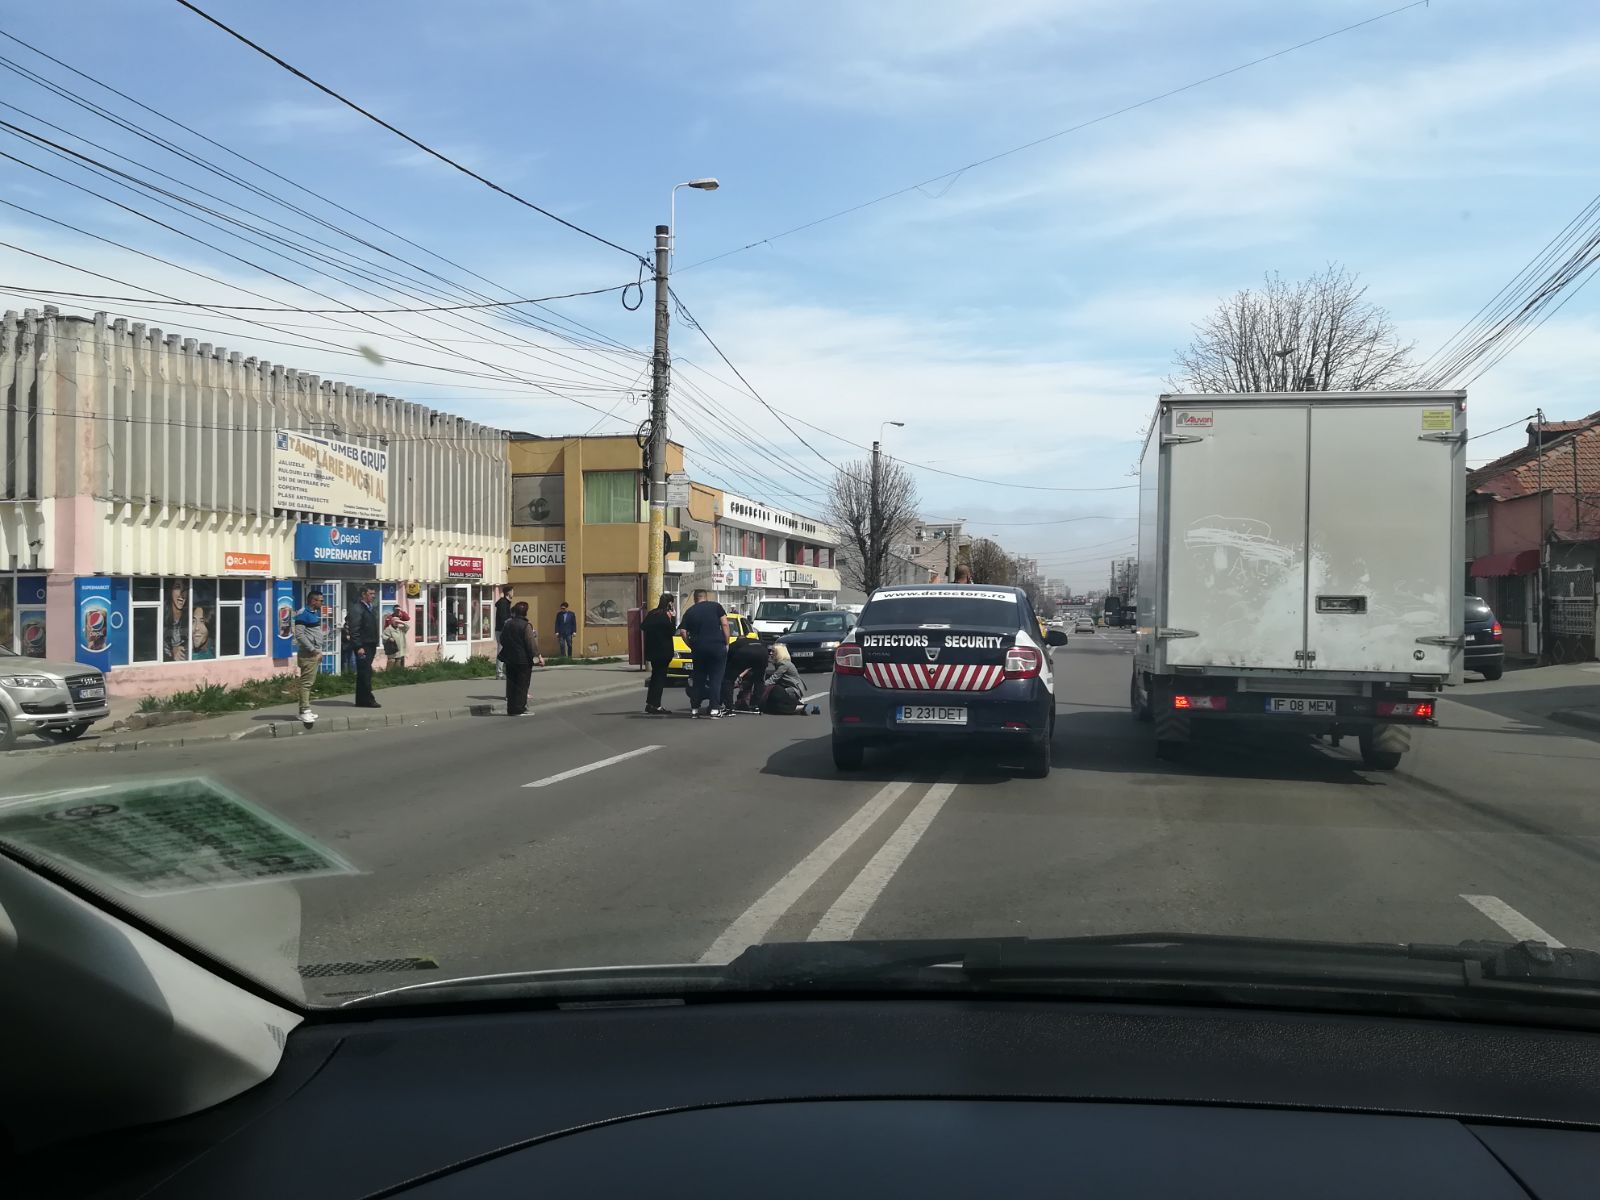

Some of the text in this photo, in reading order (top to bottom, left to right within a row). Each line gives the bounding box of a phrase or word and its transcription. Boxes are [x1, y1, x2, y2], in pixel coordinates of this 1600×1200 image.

[330, 442, 387, 474] UMEB GRUP
[345, 463, 364, 491] PVC
[375, 477, 386, 504] AL
[277, 491, 295, 500] PLASE
[296, 502, 315, 511] GARAJ
[340, 533, 361, 544] pepsi
[513, 543, 565, 553] CABINETE
[314, 547, 372, 561] SUPERMARKET
[513, 554, 565, 564] MEDICALE
[233, 556, 248, 565] RCA
[453, 559, 471, 567] SPORT
[884, 590, 1006, 600] www.detectors.ro
[863, 635, 1003, 649] DETECTORS SECURITY
[1274, 699, 1334, 712] IF 08 MEM
[903, 707, 964, 720] B 231 DET
